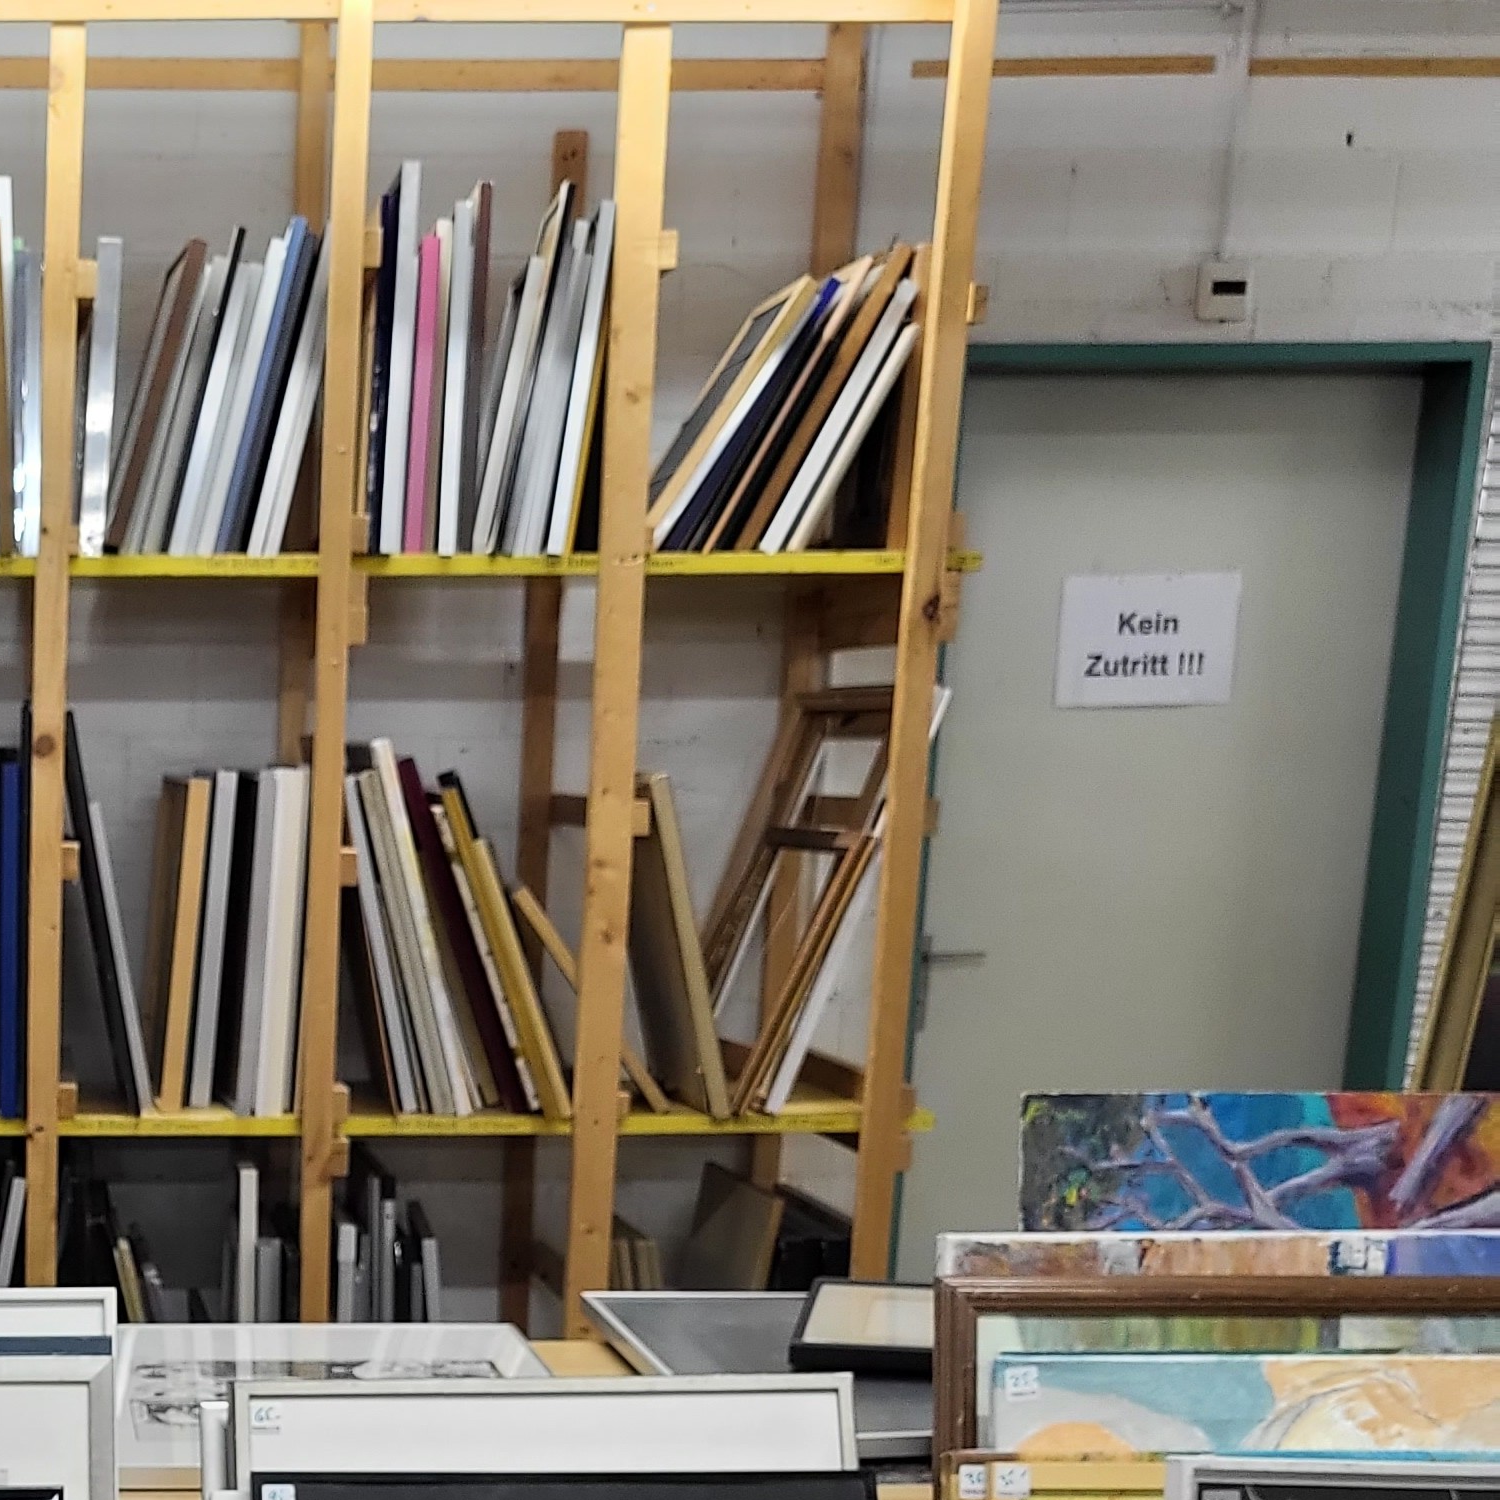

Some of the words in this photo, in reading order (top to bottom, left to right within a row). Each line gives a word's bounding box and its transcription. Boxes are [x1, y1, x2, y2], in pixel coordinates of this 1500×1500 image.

[1117, 609, 1180, 636] Kein
[1083, 652, 1170, 677] Zutritt
[1177, 652, 1205, 676] !!!
